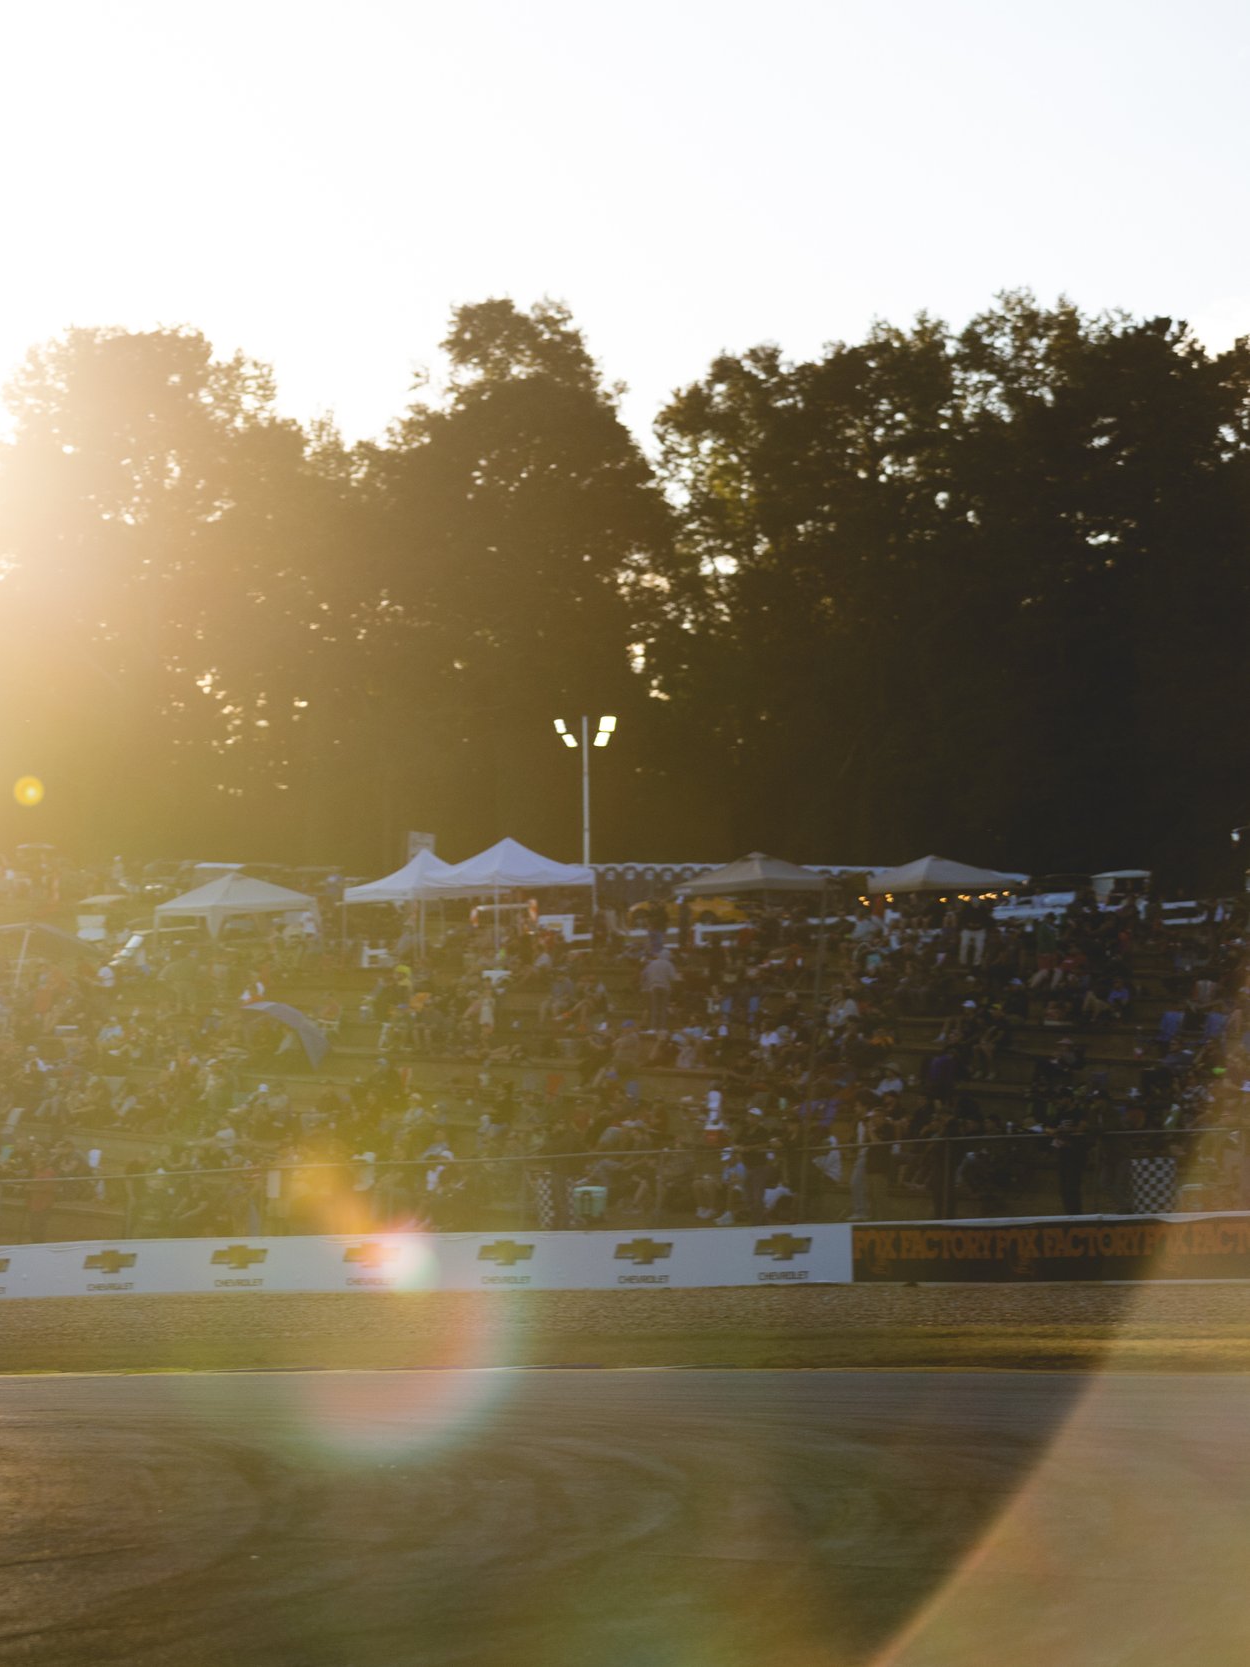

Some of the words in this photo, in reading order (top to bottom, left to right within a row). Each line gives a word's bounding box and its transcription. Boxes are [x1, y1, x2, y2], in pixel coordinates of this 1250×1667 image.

[481, 1275, 531, 1284] CHEVROLET
[618, 1275, 669, 1284] CHEVROLET
[757, 1271, 809, 1281] CHEVROLET
[87, 1281, 134, 1291] CHEVROLET
[214, 1278, 264, 1288] CHEVROLET
